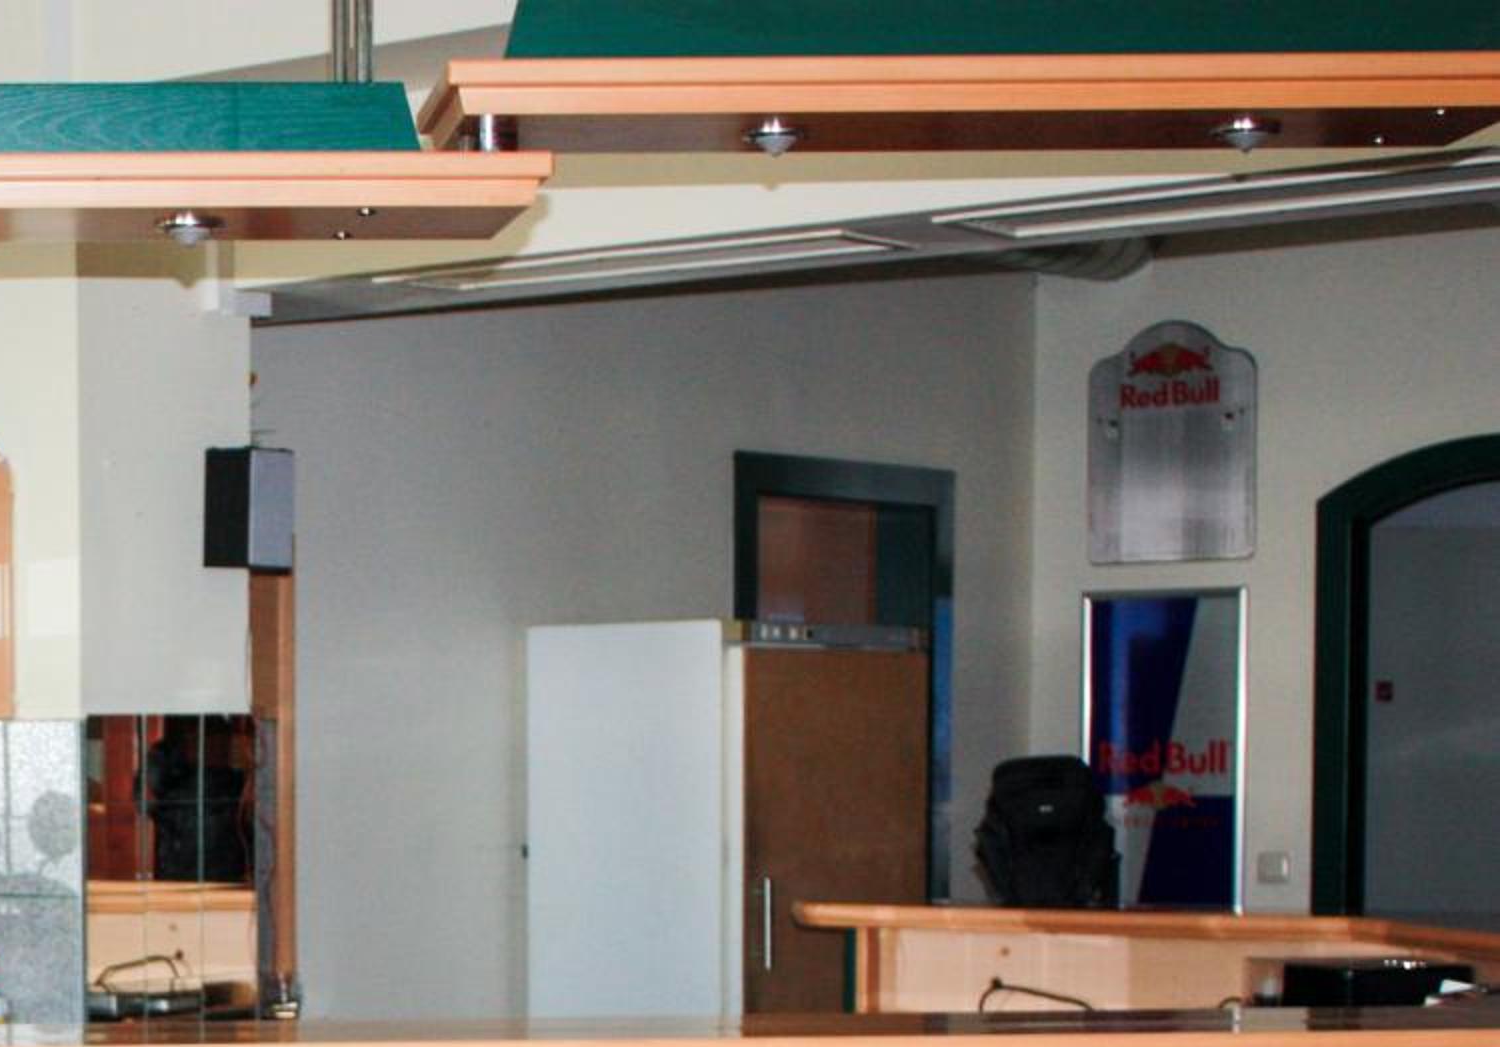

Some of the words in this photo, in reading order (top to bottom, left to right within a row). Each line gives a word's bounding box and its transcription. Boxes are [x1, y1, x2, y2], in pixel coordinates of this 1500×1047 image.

[1120, 382, 1169, 408] Red
[1171, 376, 1220, 406] Bull
[1098, 739, 1160, 775] Red
[1165, 738, 1227, 775] Bull
